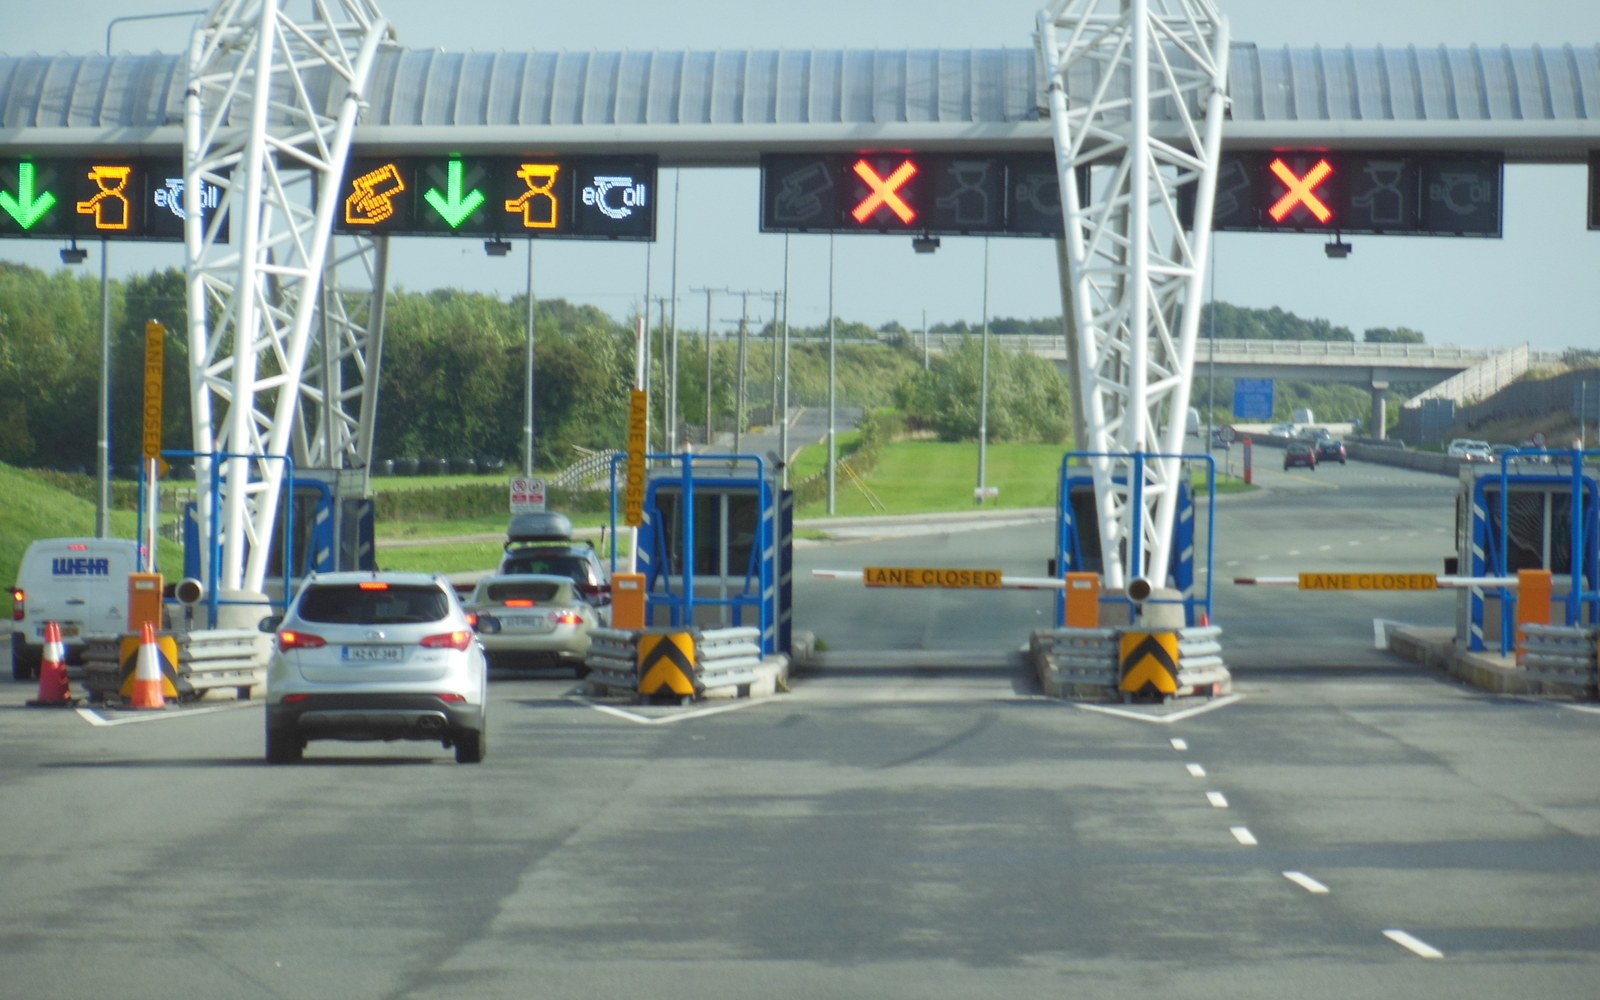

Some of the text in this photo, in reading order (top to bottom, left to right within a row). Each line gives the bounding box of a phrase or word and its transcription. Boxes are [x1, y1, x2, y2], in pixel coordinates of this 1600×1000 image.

[145, 328, 161, 455] LANE CLOSED
[627, 395, 644, 523] LANE CLOSED
[866, 569, 998, 585] LANE CLOSED
[1303, 573, 1434, 590] LANE CLOSED
